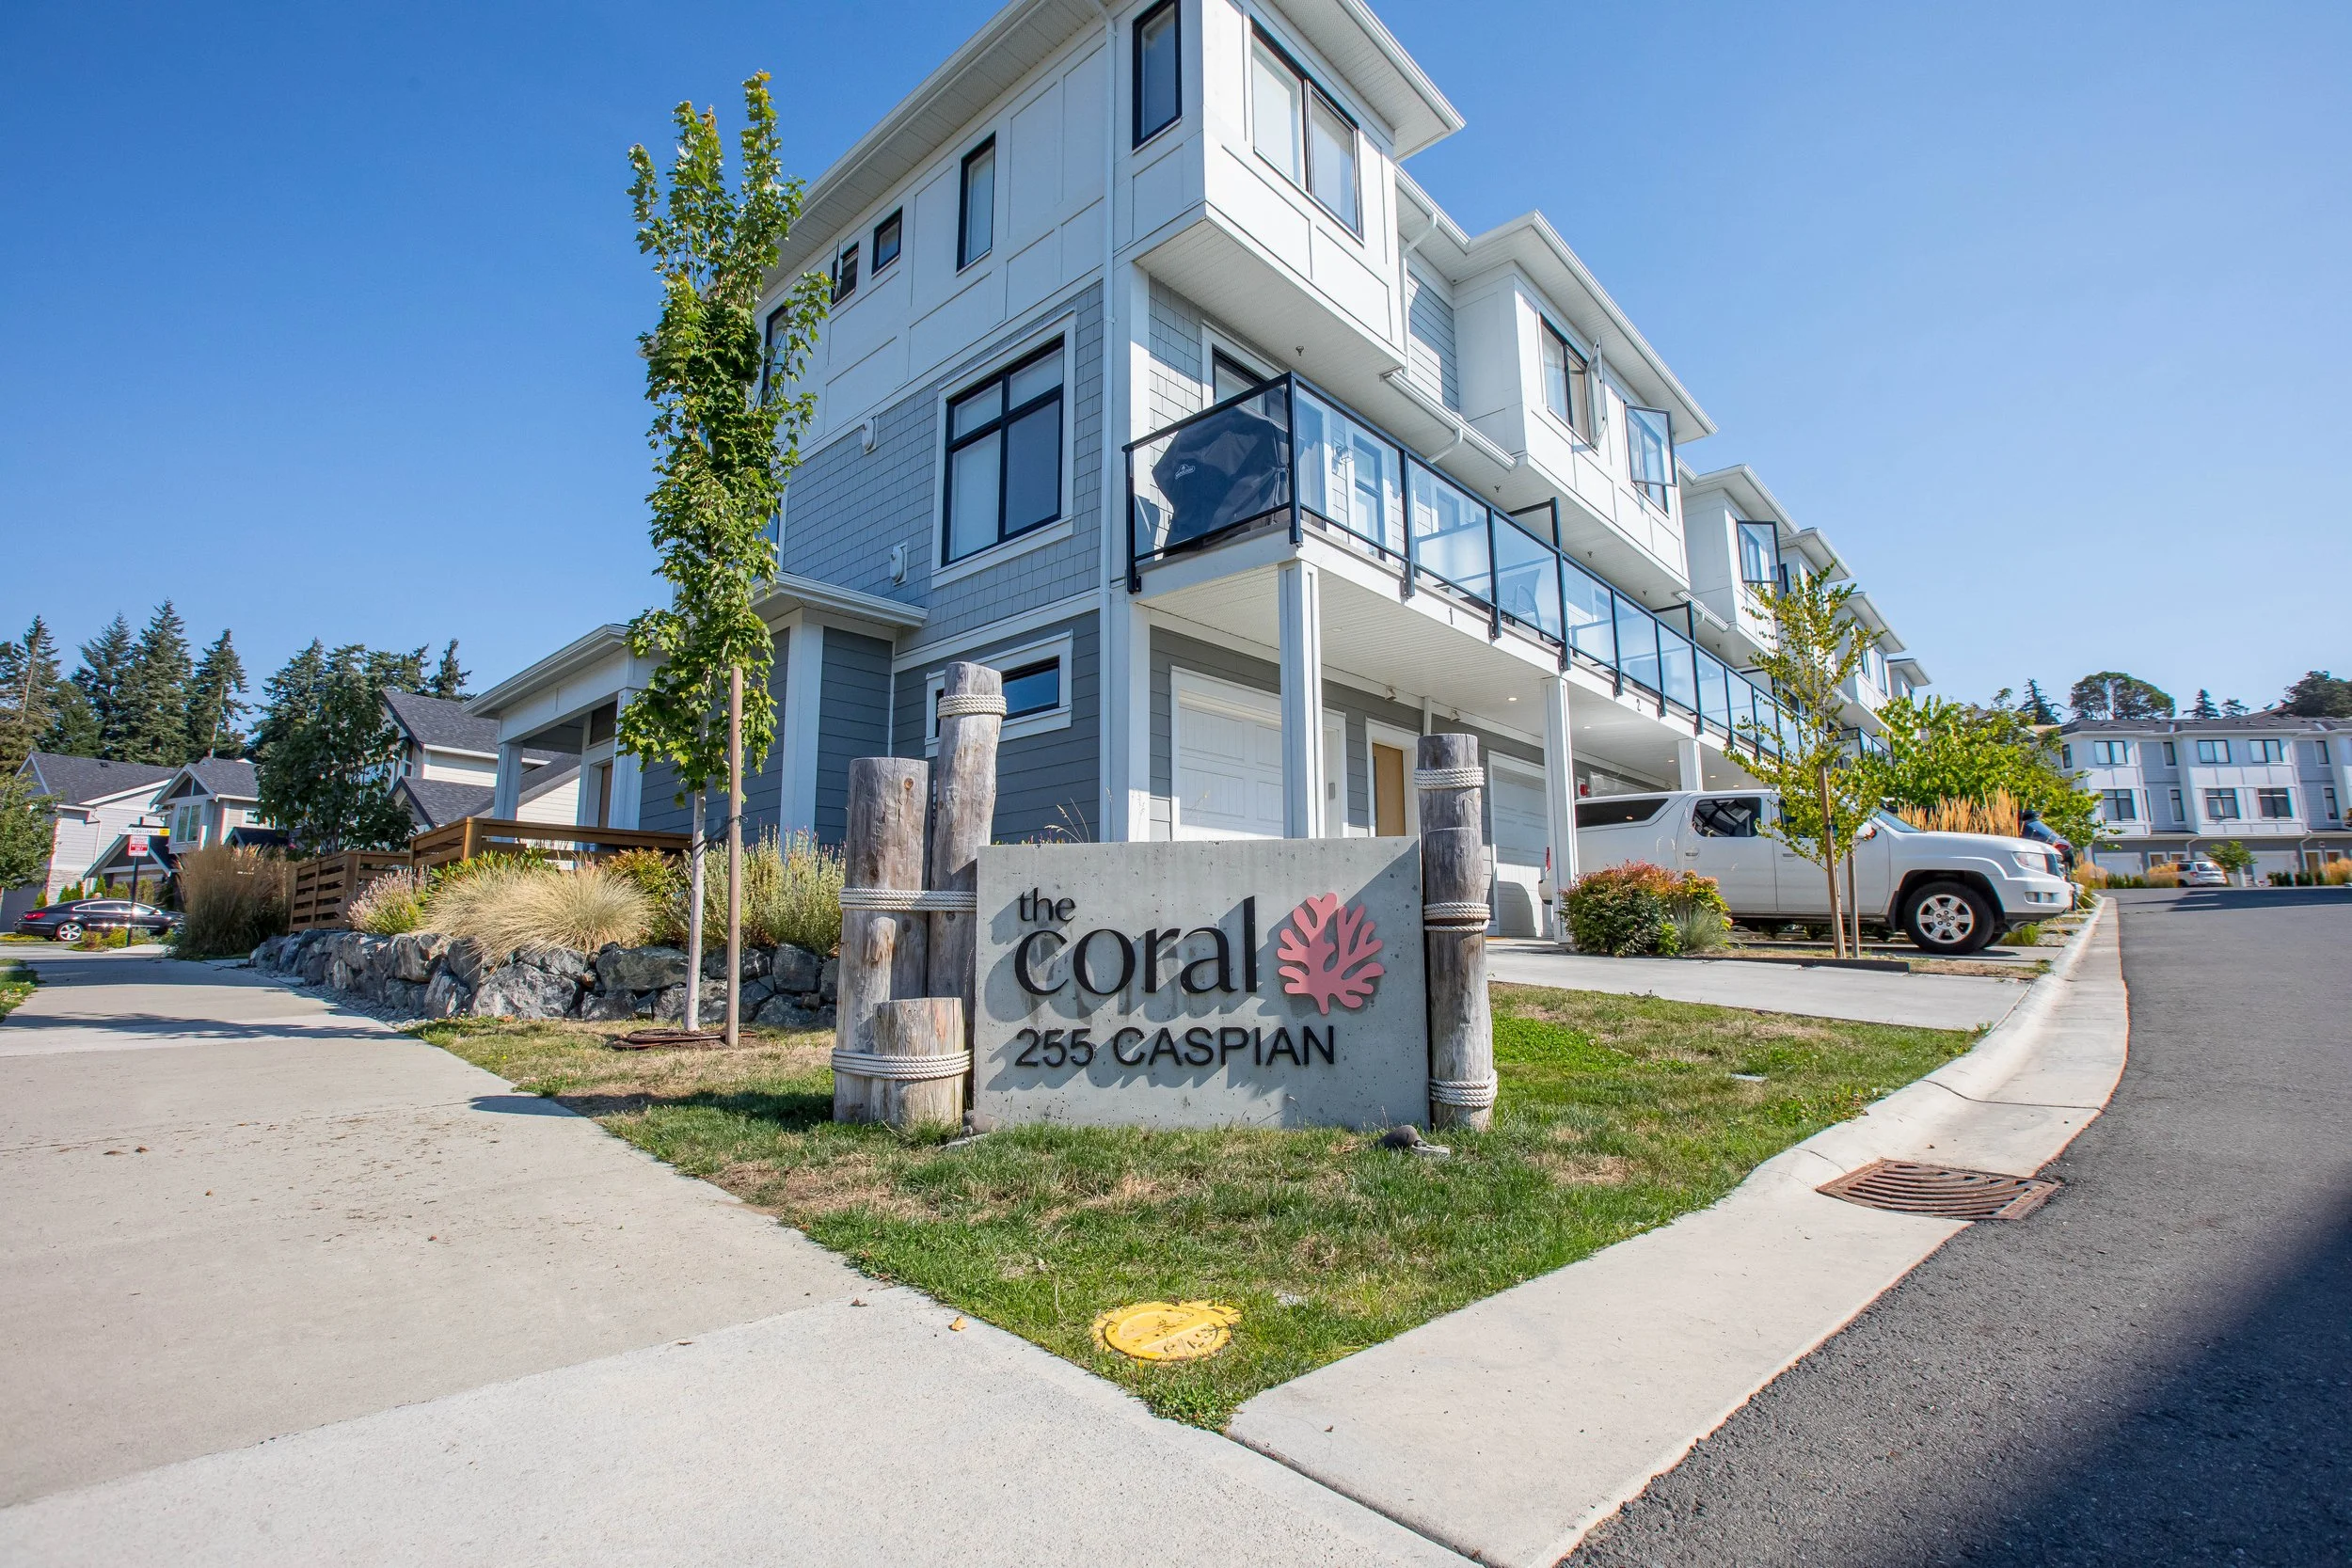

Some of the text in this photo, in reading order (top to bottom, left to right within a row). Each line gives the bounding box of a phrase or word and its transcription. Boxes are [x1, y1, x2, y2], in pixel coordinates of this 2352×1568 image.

[1448, 607, 1454, 626] 1
[1636, 698, 1642, 712] 2
[1018, 887, 1076, 922] the
[1014, 895, 1257, 996] coral
[1014, 1025, 1335, 1068] 255 CASPIAN
